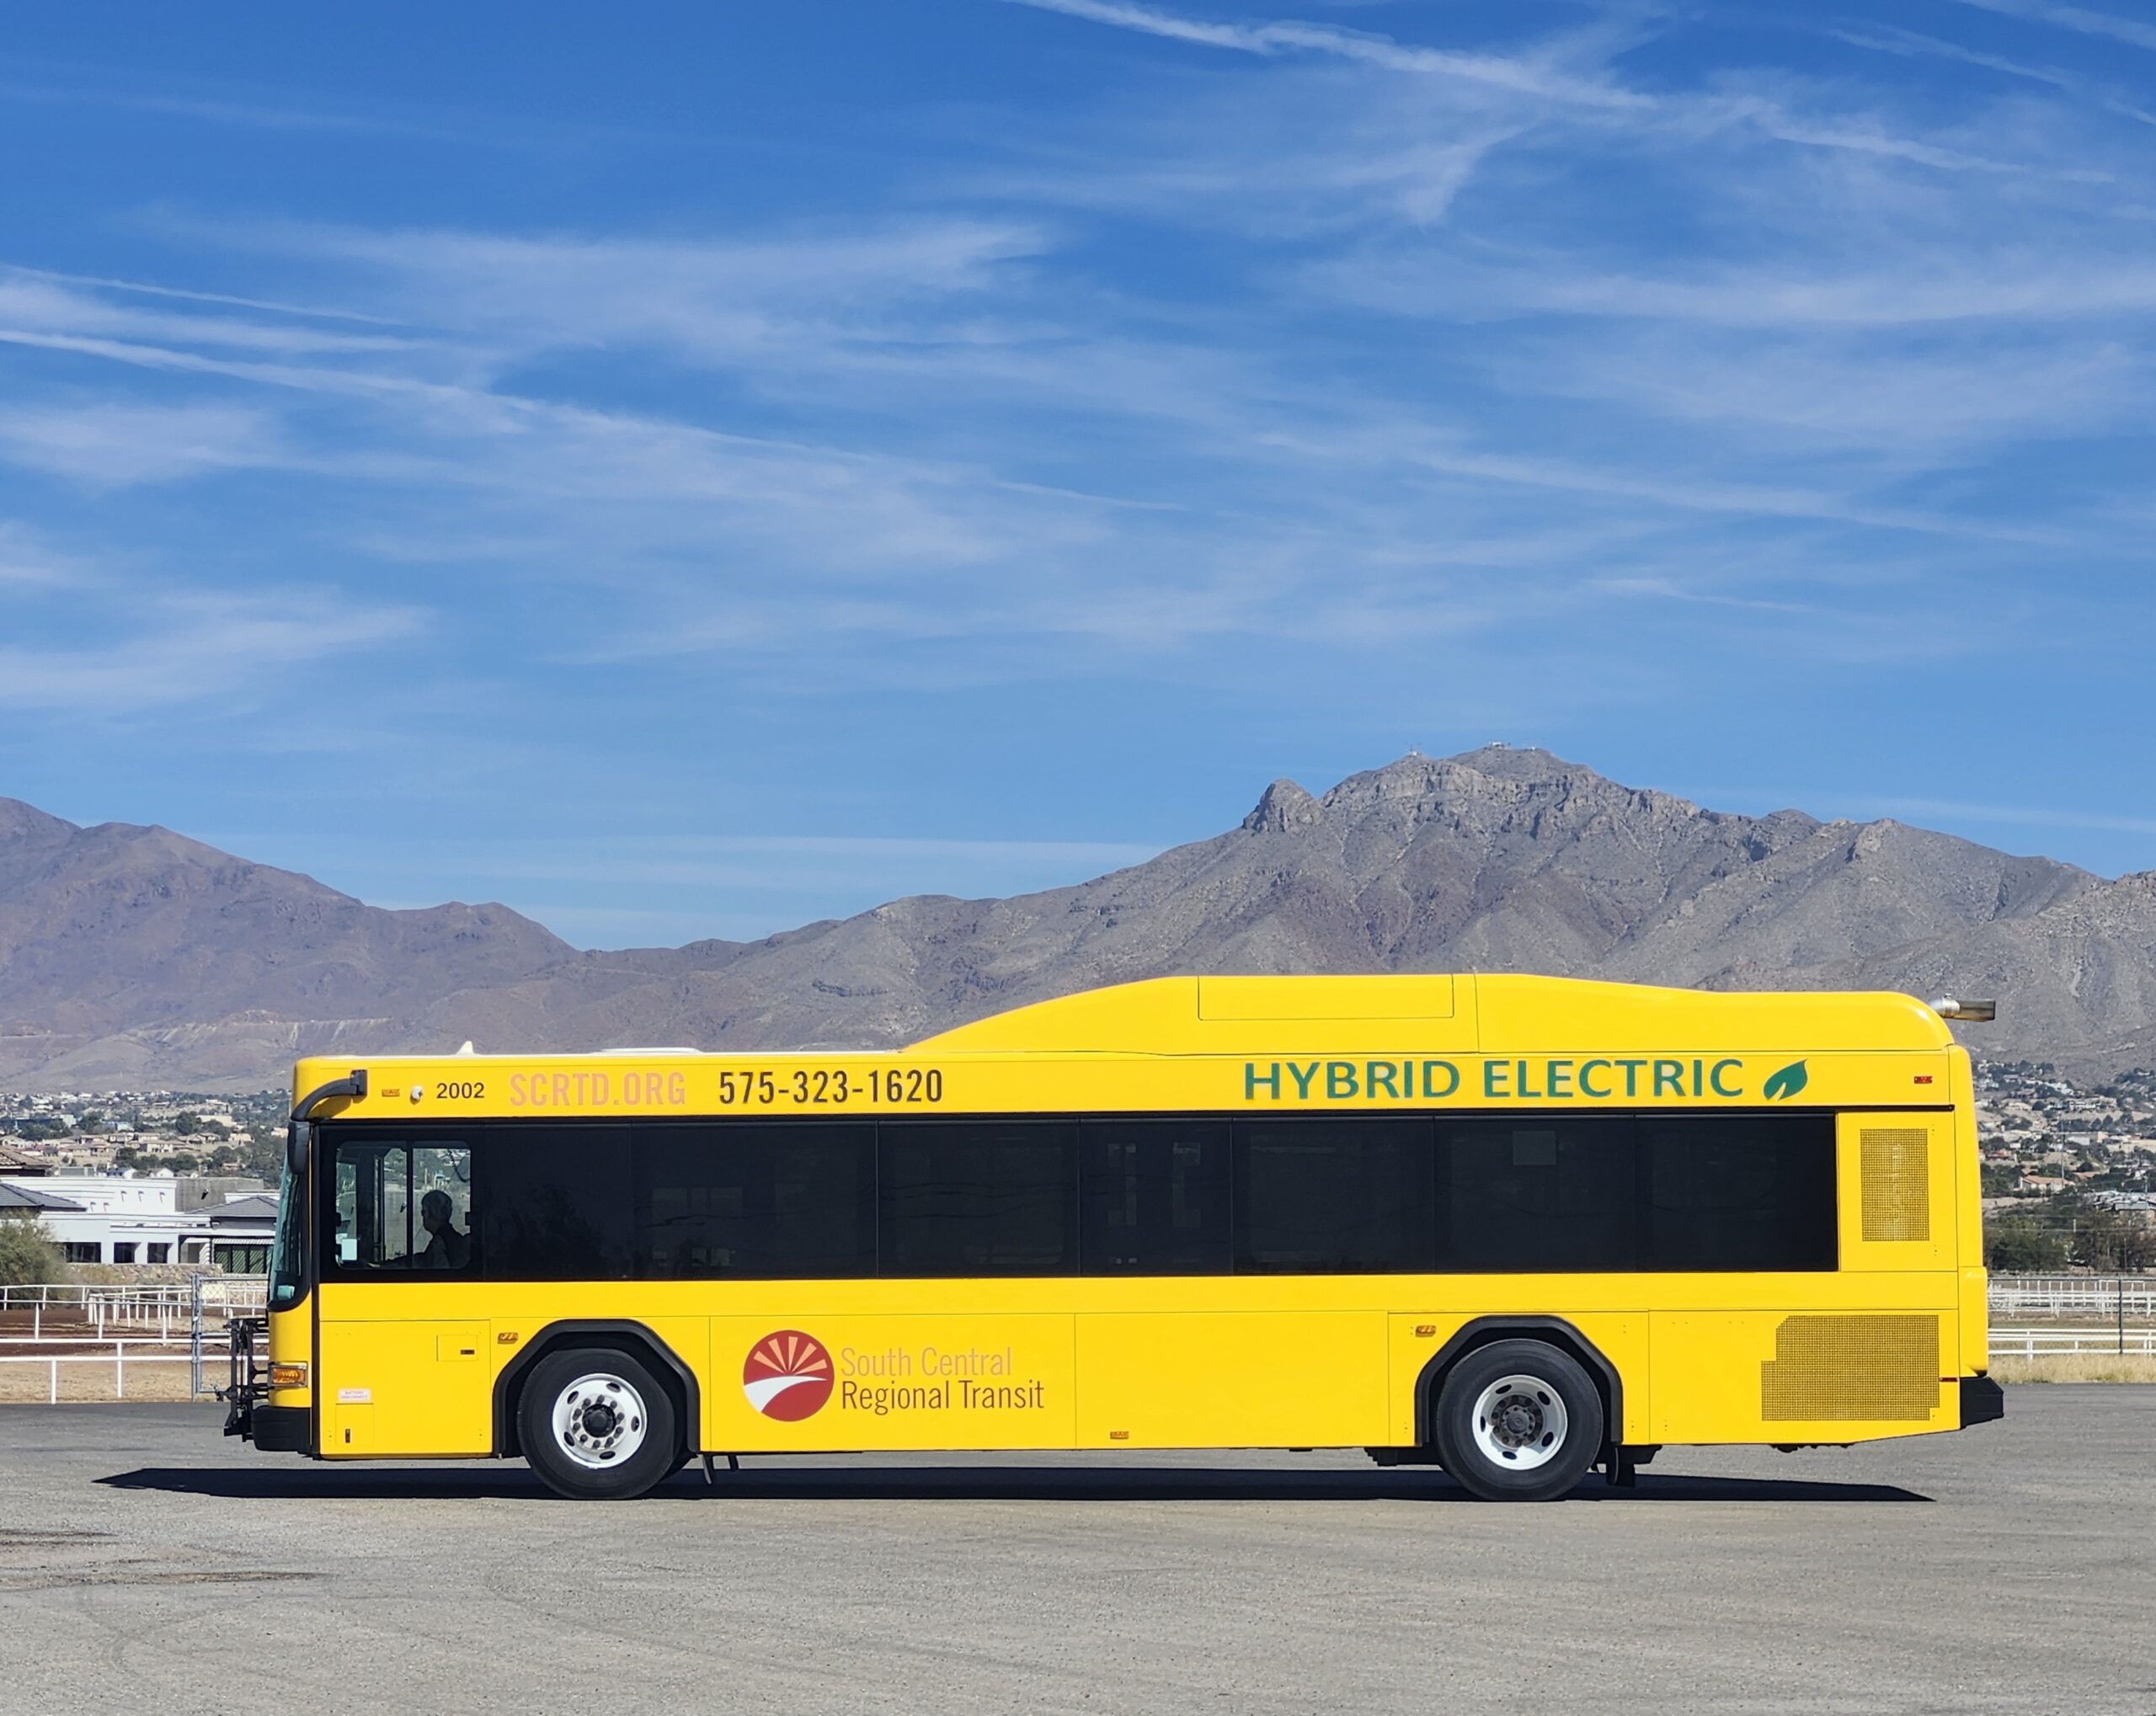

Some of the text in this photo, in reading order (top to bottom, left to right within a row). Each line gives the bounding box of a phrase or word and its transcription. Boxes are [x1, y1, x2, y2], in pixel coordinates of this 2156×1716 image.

[436, 1082, 485, 1099] 2002
[510, 1072, 686, 1106] SCRTD.ORG
[719, 1069, 942, 1104] 575-323-1620
[1245, 1058, 1742, 1100] HYBRID ELECTRIC
[841, 1346, 1011, 1377] South Central
[842, 1379, 1044, 1415] Regional Transit
